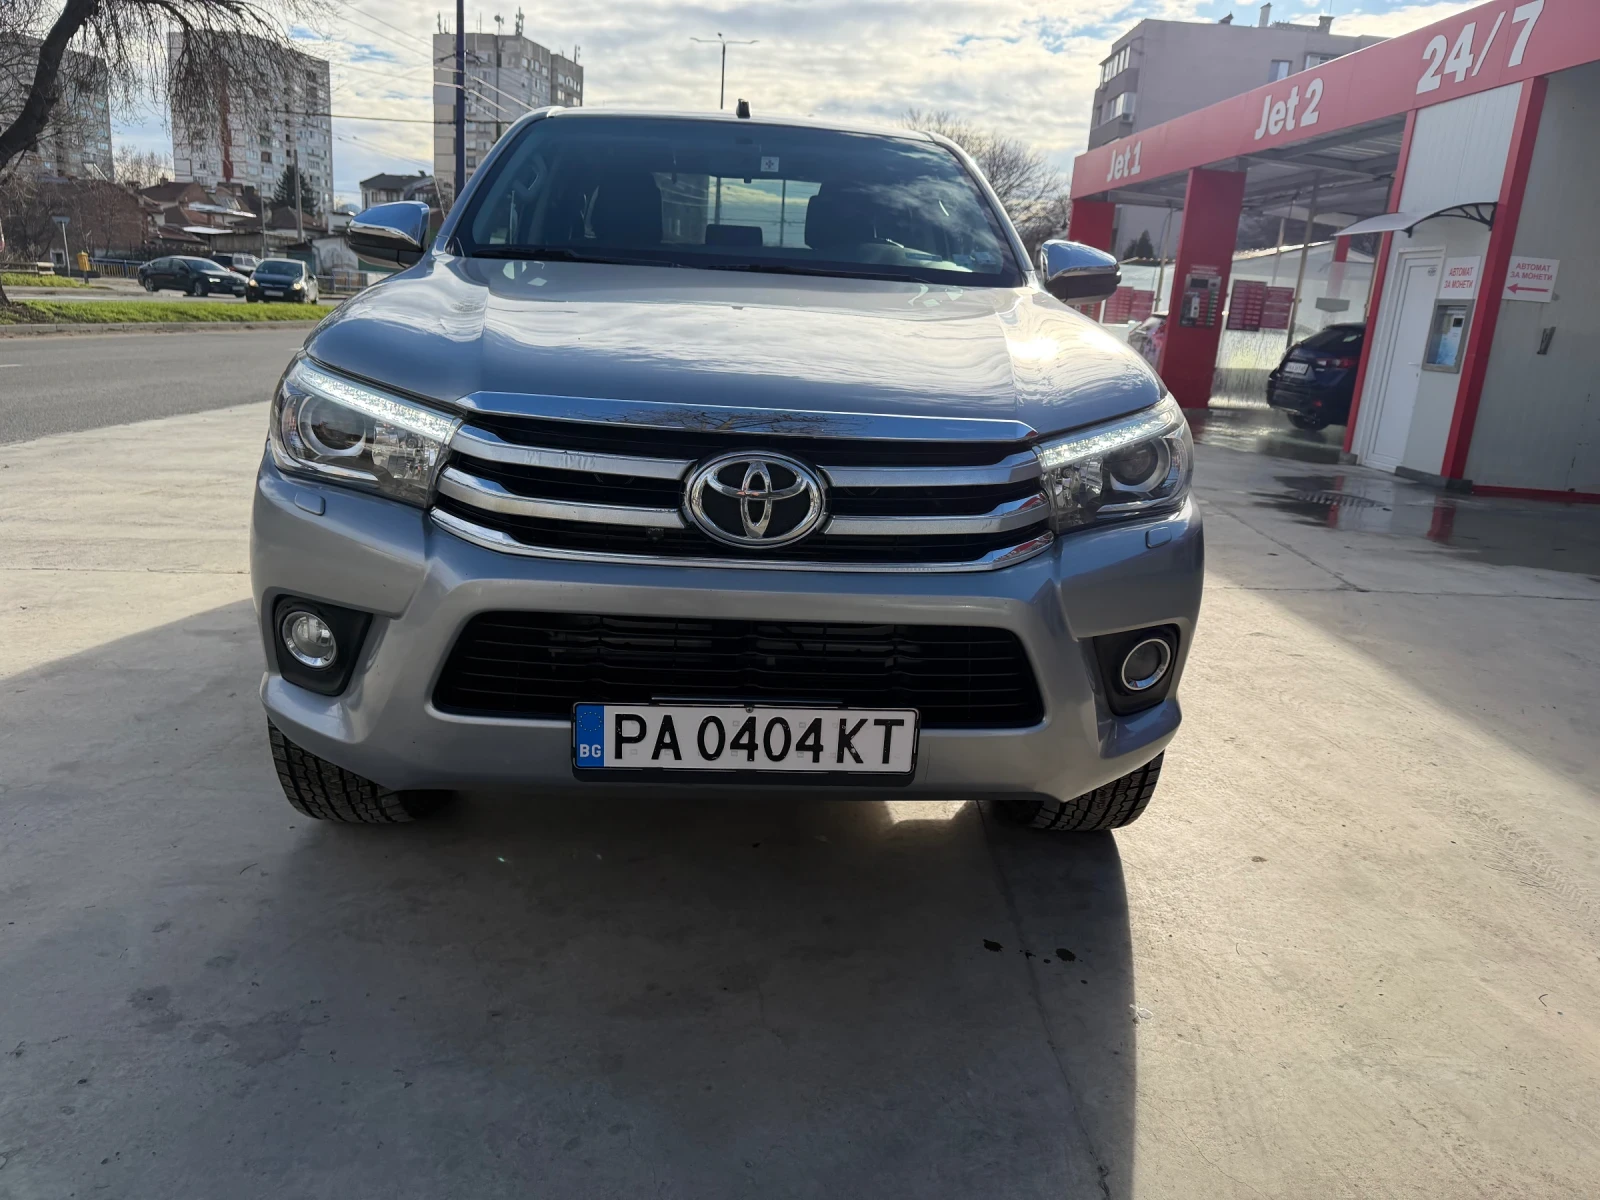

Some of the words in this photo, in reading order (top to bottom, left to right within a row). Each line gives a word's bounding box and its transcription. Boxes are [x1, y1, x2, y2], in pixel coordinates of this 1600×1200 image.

[1415, 0, 1545, 95] 24/7
[1254, 86, 1300, 140] Jet
[1300, 77, 1324, 127] 2
[1106, 144, 1131, 182] Jet
[1131, 140, 1142, 175] 1
[1449, 267, 1474, 276] АВТОМАТ
[1516, 262, 1552, 272] АВТОМАТ
[1521, 272, 1553, 281] МОНЕТИ
[1444, 280, 1451, 288] ЗА
[1452, 280, 1473, 288] МОНЕТИ
[579, 744, 602, 758] BG
